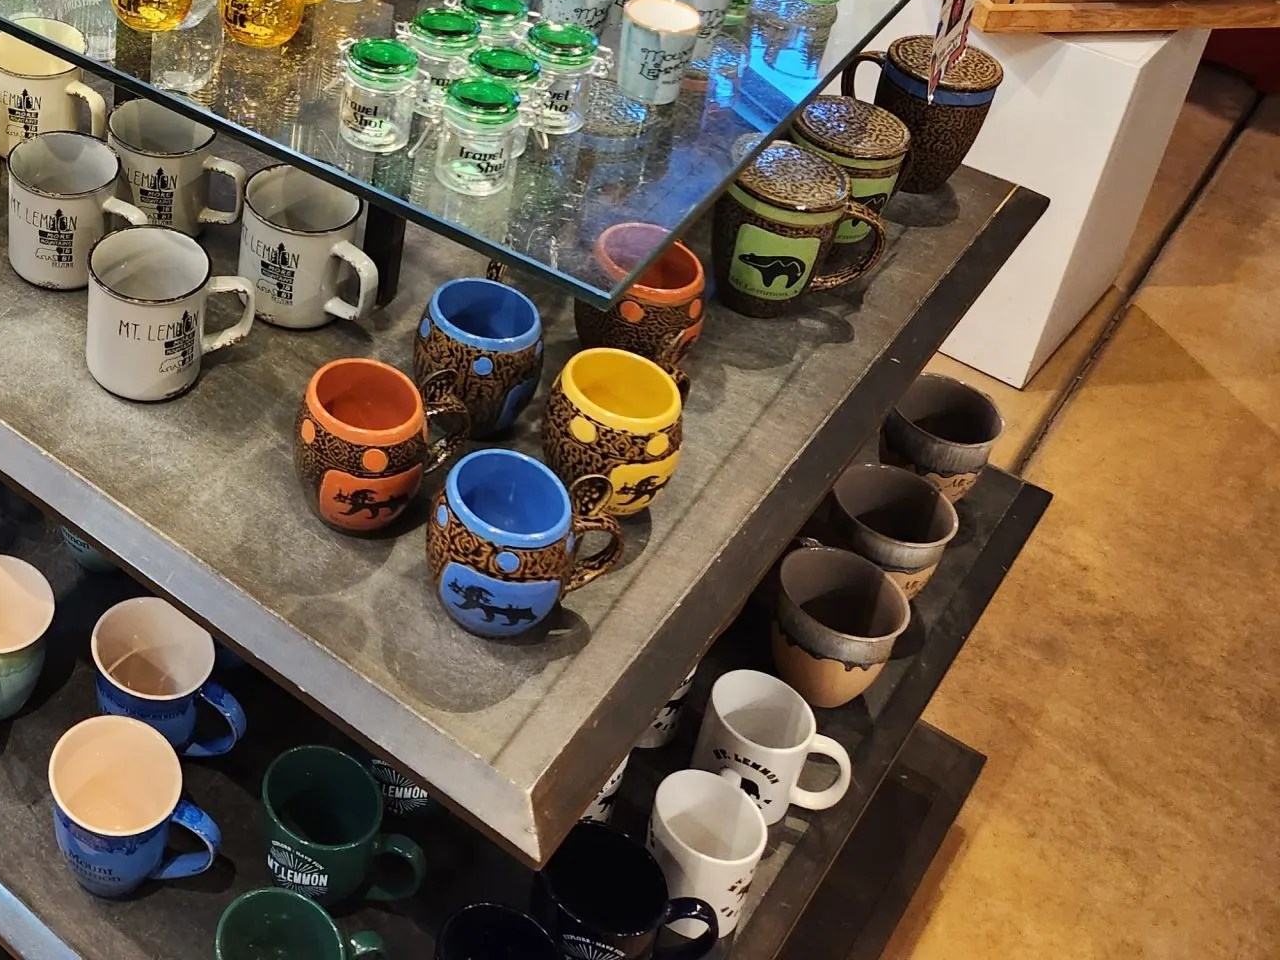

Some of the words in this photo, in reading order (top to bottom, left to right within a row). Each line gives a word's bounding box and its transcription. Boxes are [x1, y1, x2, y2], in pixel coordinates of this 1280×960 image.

[224, 5, 248, 28] Lit
[344, 96, 379, 117] Travel
[352, 111, 385, 128] Shot
[459, 146, 505, 161] Travel
[476, 161, 507, 175] Shot
[126, 168, 179, 191] LEMMON
[140, 196, 172, 205] MOUNTAINS
[25, 207, 78, 231] LEMMON
[40, 238, 73, 247] MOUNTAINS
[250, 235, 300, 269] LEMMON
[268, 264, 292, 277] MORE
[118, 320, 141, 341] MT.
[148, 310, 200, 341] LEMMON
[733, 753, 780, 784] LEMMON
[382, 783, 429, 799] LEMMON
[68, 851, 113, 876] Mount
[296, 850, 313, 862] HAVE
[280, 869, 329, 887] LEMMON
[596, 941, 614, 951] HAVE
